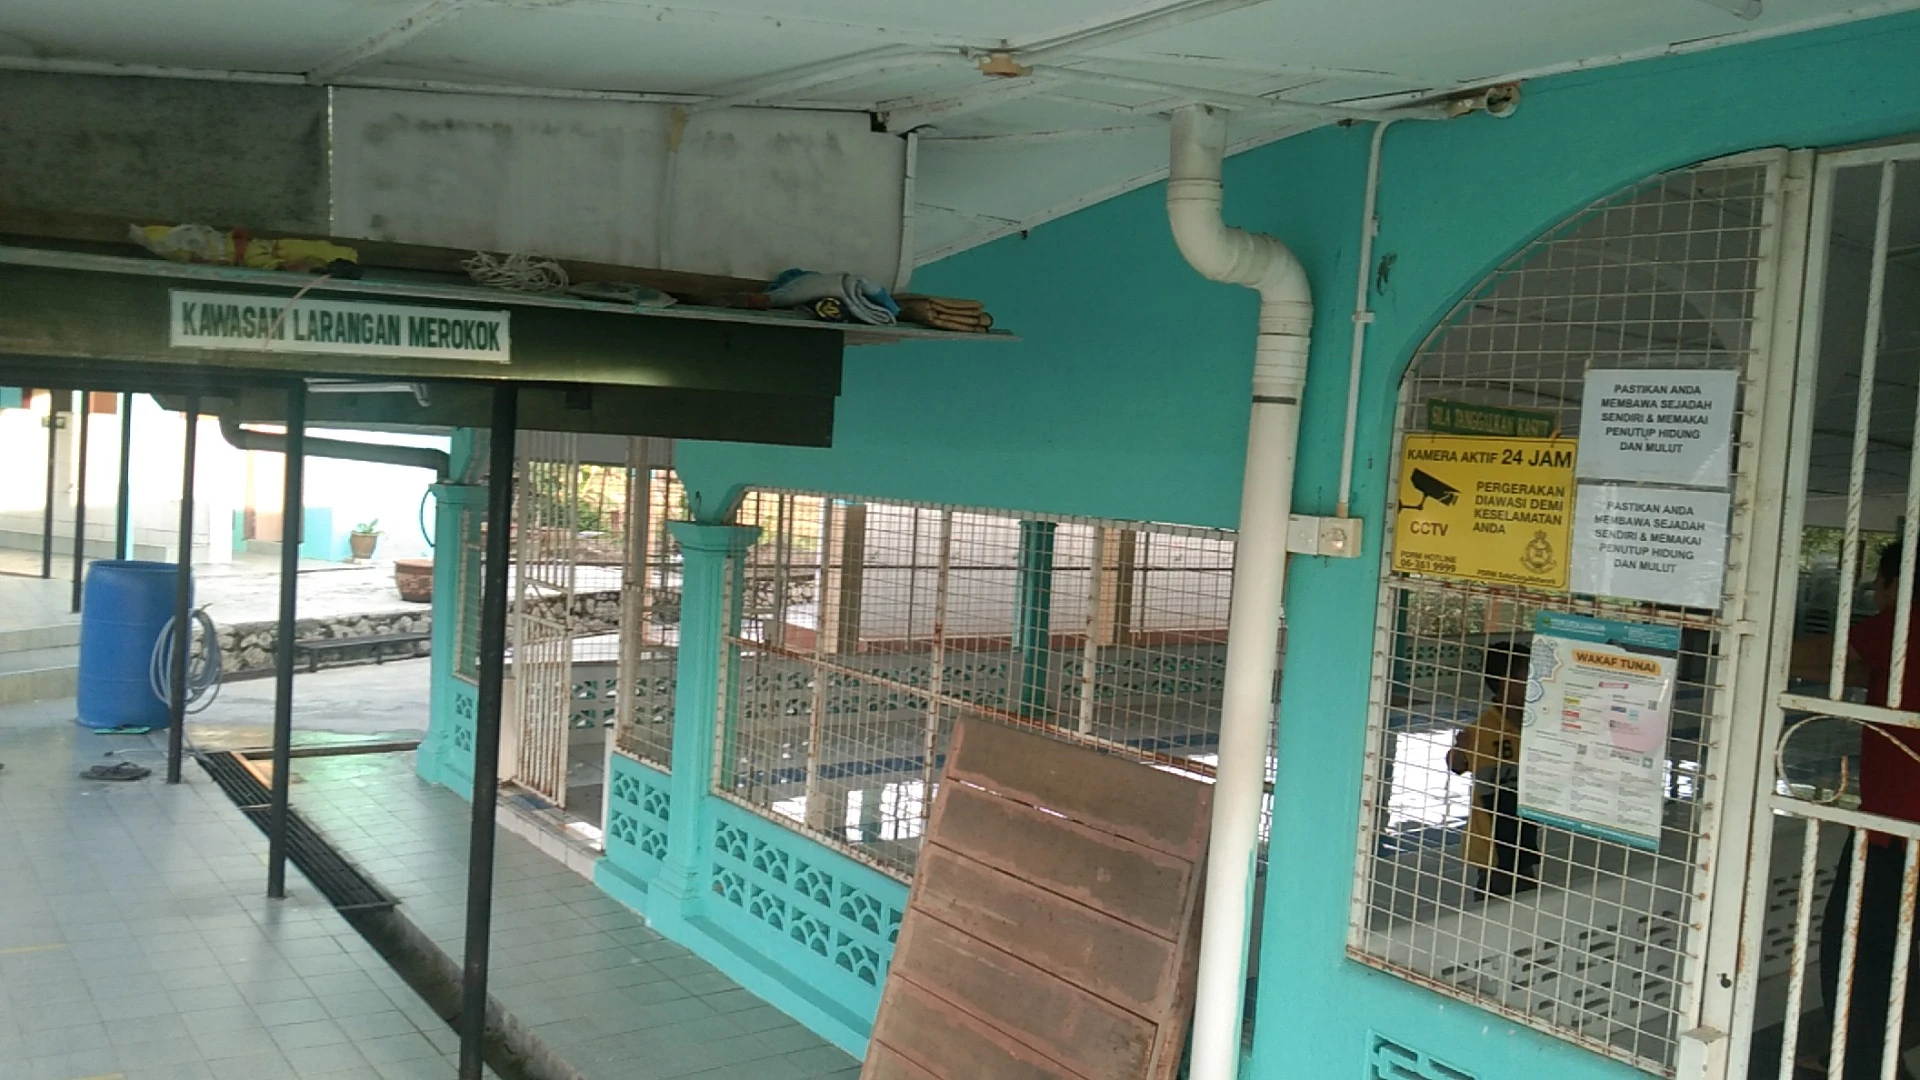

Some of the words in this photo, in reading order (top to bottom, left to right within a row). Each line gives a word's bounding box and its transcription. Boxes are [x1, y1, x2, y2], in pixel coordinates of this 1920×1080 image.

[181, 301, 285, 341] KAWASAN
[293, 308, 401, 346] LARANGAN
[408, 315, 502, 352] MEROKOK
[1614, 384, 1667, 394] PASTIKAN
[1670, 385, 1701, 395] ANDA
[1601, 398, 1658, 409] MEMBAWA
[1660, 400, 1712, 410] SEJADAH
[1601, 412, 1644, 423] SENDIRI
[1646, 414, 1654, 423] &
[1657, 415, 1709, 424] MEMAKAI
[1605, 427, 1656, 437] PENUTUP
[1658, 429, 1700, 439] HIDUNG
[1620, 442, 1643, 451] DAN
[1645, 443, 1683, 453] MULUT
[1407, 449, 1457, 462] KAMERA
[1461, 451, 1498, 464] AKTIF
[1501, 449, 1523, 465] 24
[1528, 451, 1572, 468] JAM
[1476, 481, 1565, 497] PERGERAKAN
[1475, 495, 1526, 509] DIAWASI
[1530, 499, 1563, 512] DEMI
[1606, 502, 1660, 513] PASTIKAN
[1663, 505, 1694, 515] ANDA
[1474, 508, 1562, 525] KESELAMATAN
[1594, 515, 1650, 527] MEMBAWA
[1653, 519, 1705, 531] SEJADAH
[1410, 521, 1449, 536] CCTV
[1473, 522, 1506, 534] ANDA
[1594, 529, 1638, 540] SENDIRI
[1639, 532, 1647, 541] &
[1650, 533, 1702, 546] MEMAKAI
[1424, 553, 1457, 563] HOTLINE
[1599, 543, 1649, 555] PENUTUP
[1652, 549, 1694, 560] HIDUNG
[1432, 562, 1456, 572] 9999
[1613, 558, 1636, 569] DAN
[1639, 560, 1677, 573] MULUT
[1576, 652, 1618, 668] WAKAF
[1620, 658, 1656, 673] TUNAI
